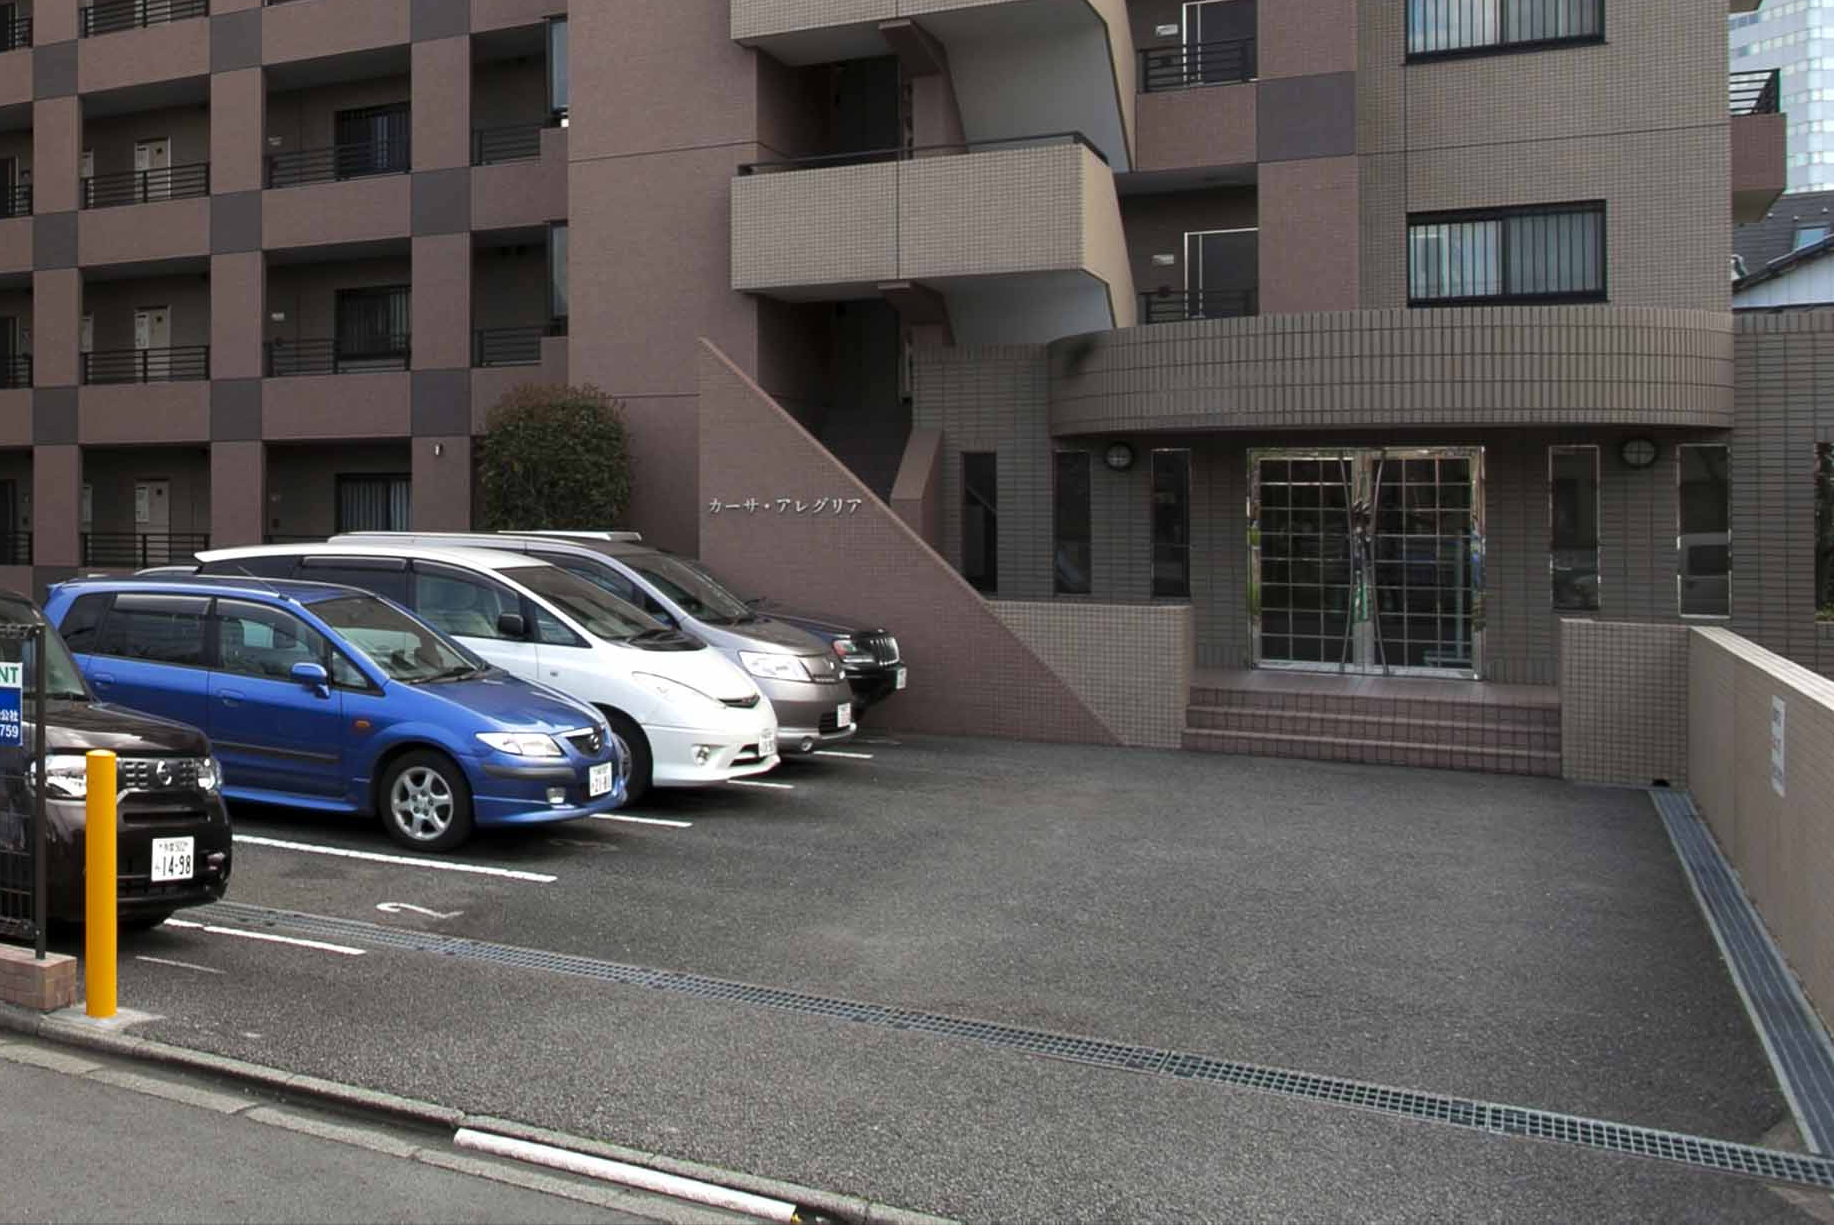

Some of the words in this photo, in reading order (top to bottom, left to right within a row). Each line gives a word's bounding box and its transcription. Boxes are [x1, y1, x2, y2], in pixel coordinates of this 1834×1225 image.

[709, 497, 863, 514] カーサ・アレグリア
